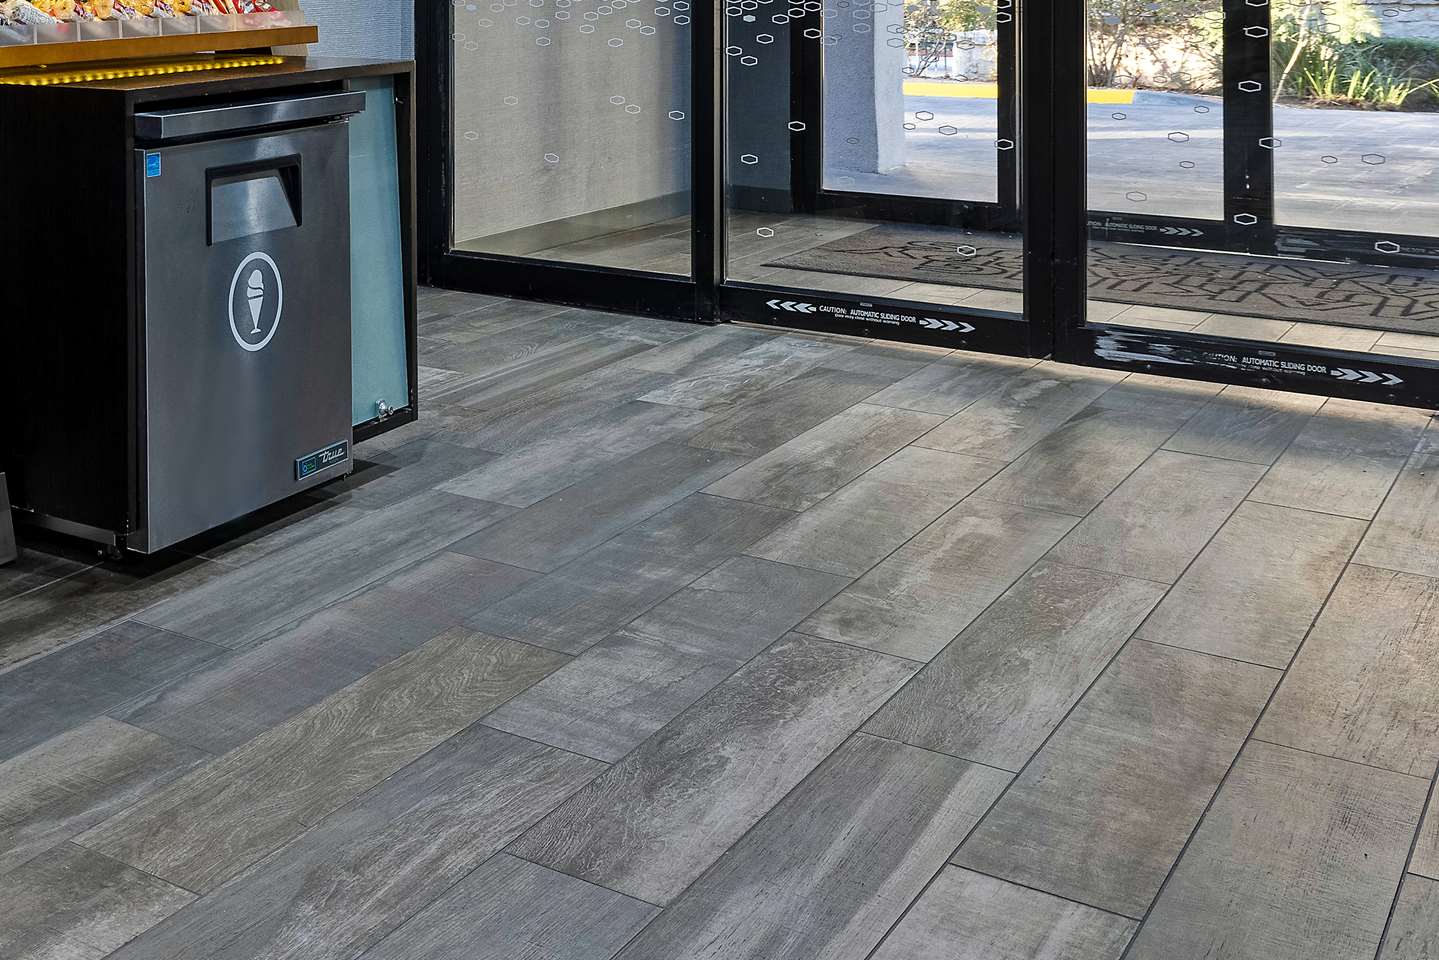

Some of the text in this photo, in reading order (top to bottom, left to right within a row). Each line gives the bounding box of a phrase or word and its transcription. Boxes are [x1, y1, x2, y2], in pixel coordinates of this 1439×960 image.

[818, 305, 916, 323] CAUTION: AUTOMATIC SLIDING DOOR
[1241, 356, 1279, 367] AUTOMATIC
[1280, 361, 1306, 371] SLIDING
[1306, 364, 1327, 374] DOOR
